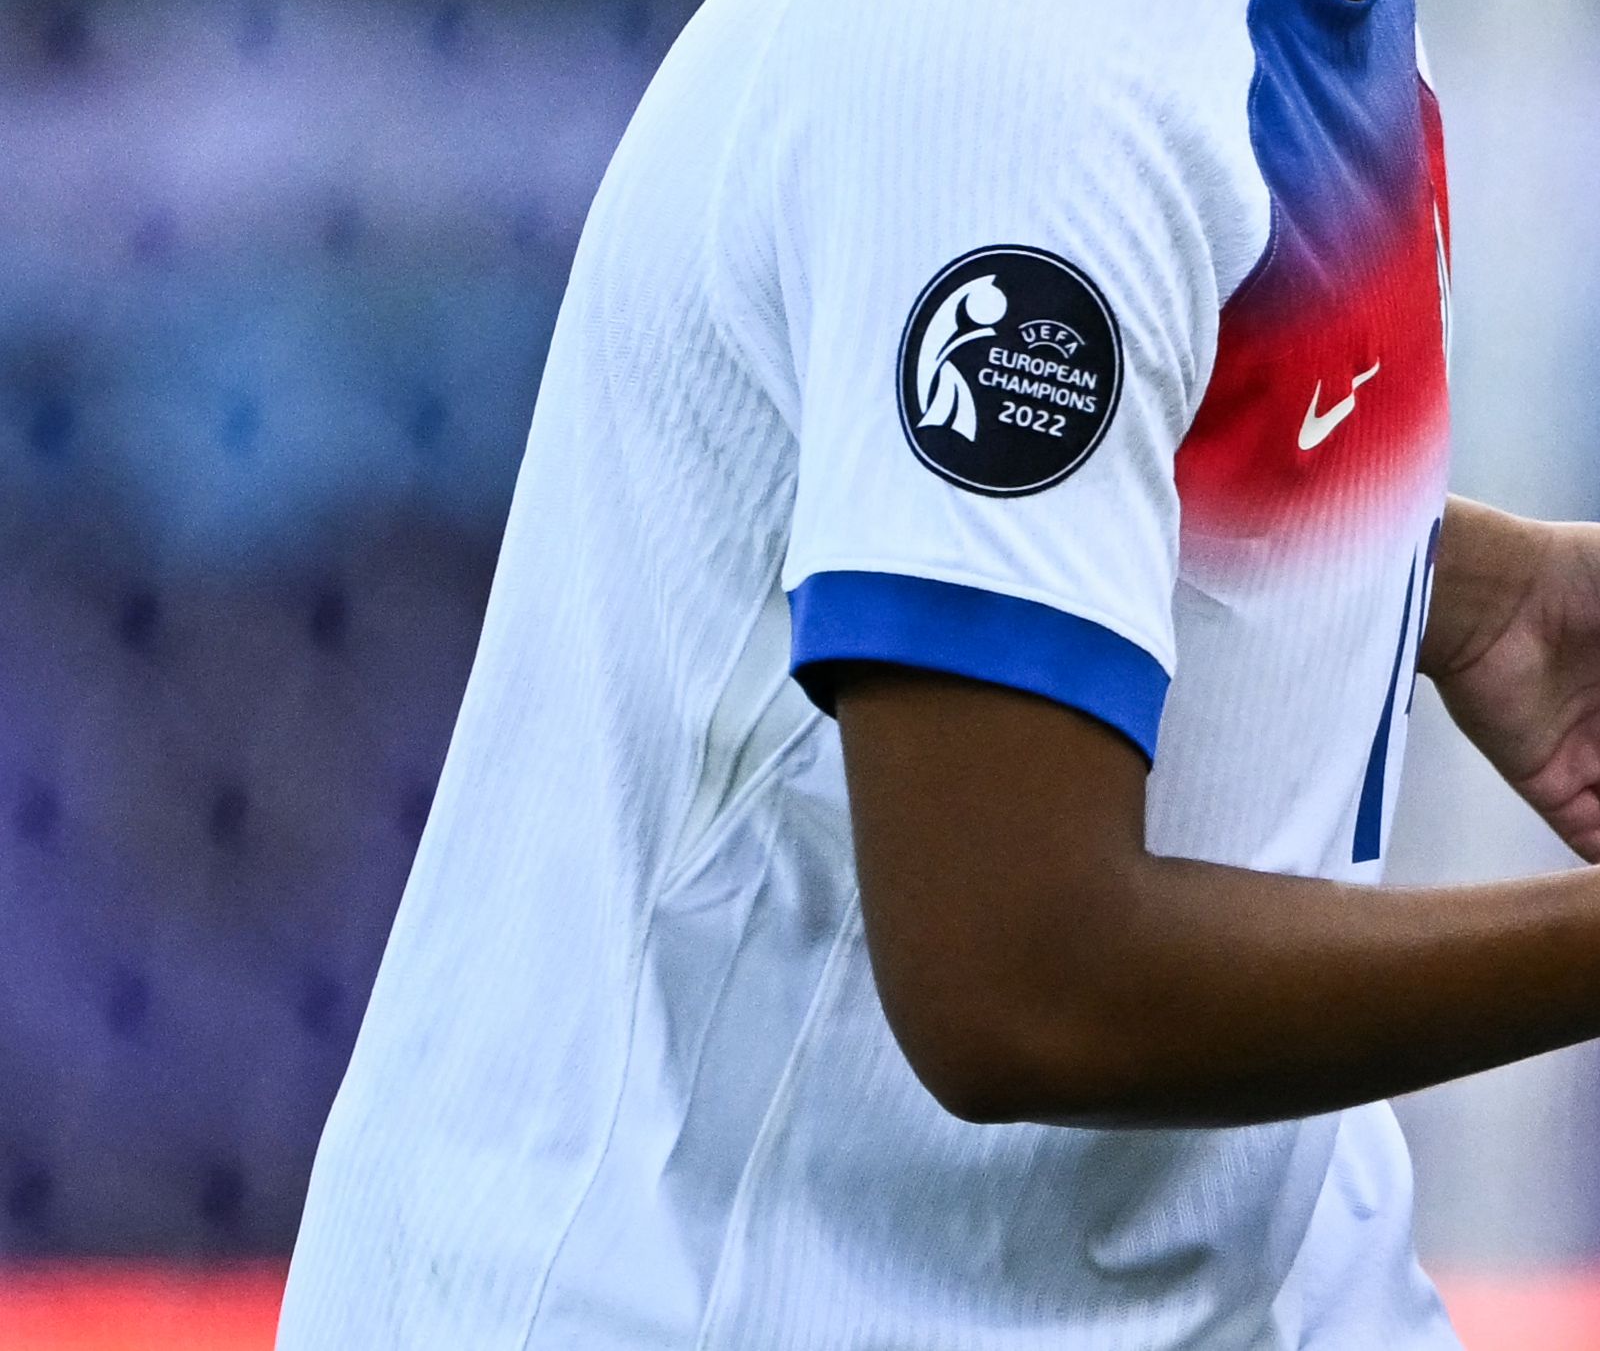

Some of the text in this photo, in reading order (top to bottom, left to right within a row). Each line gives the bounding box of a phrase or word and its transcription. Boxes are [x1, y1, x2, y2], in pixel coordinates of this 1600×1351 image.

[1020, 325, 1079, 355] UEFA
[988, 347, 1098, 390] EUROPEAN
[977, 368, 1098, 414] CHAMPIONS
[998, 401, 1067, 437] 2022
